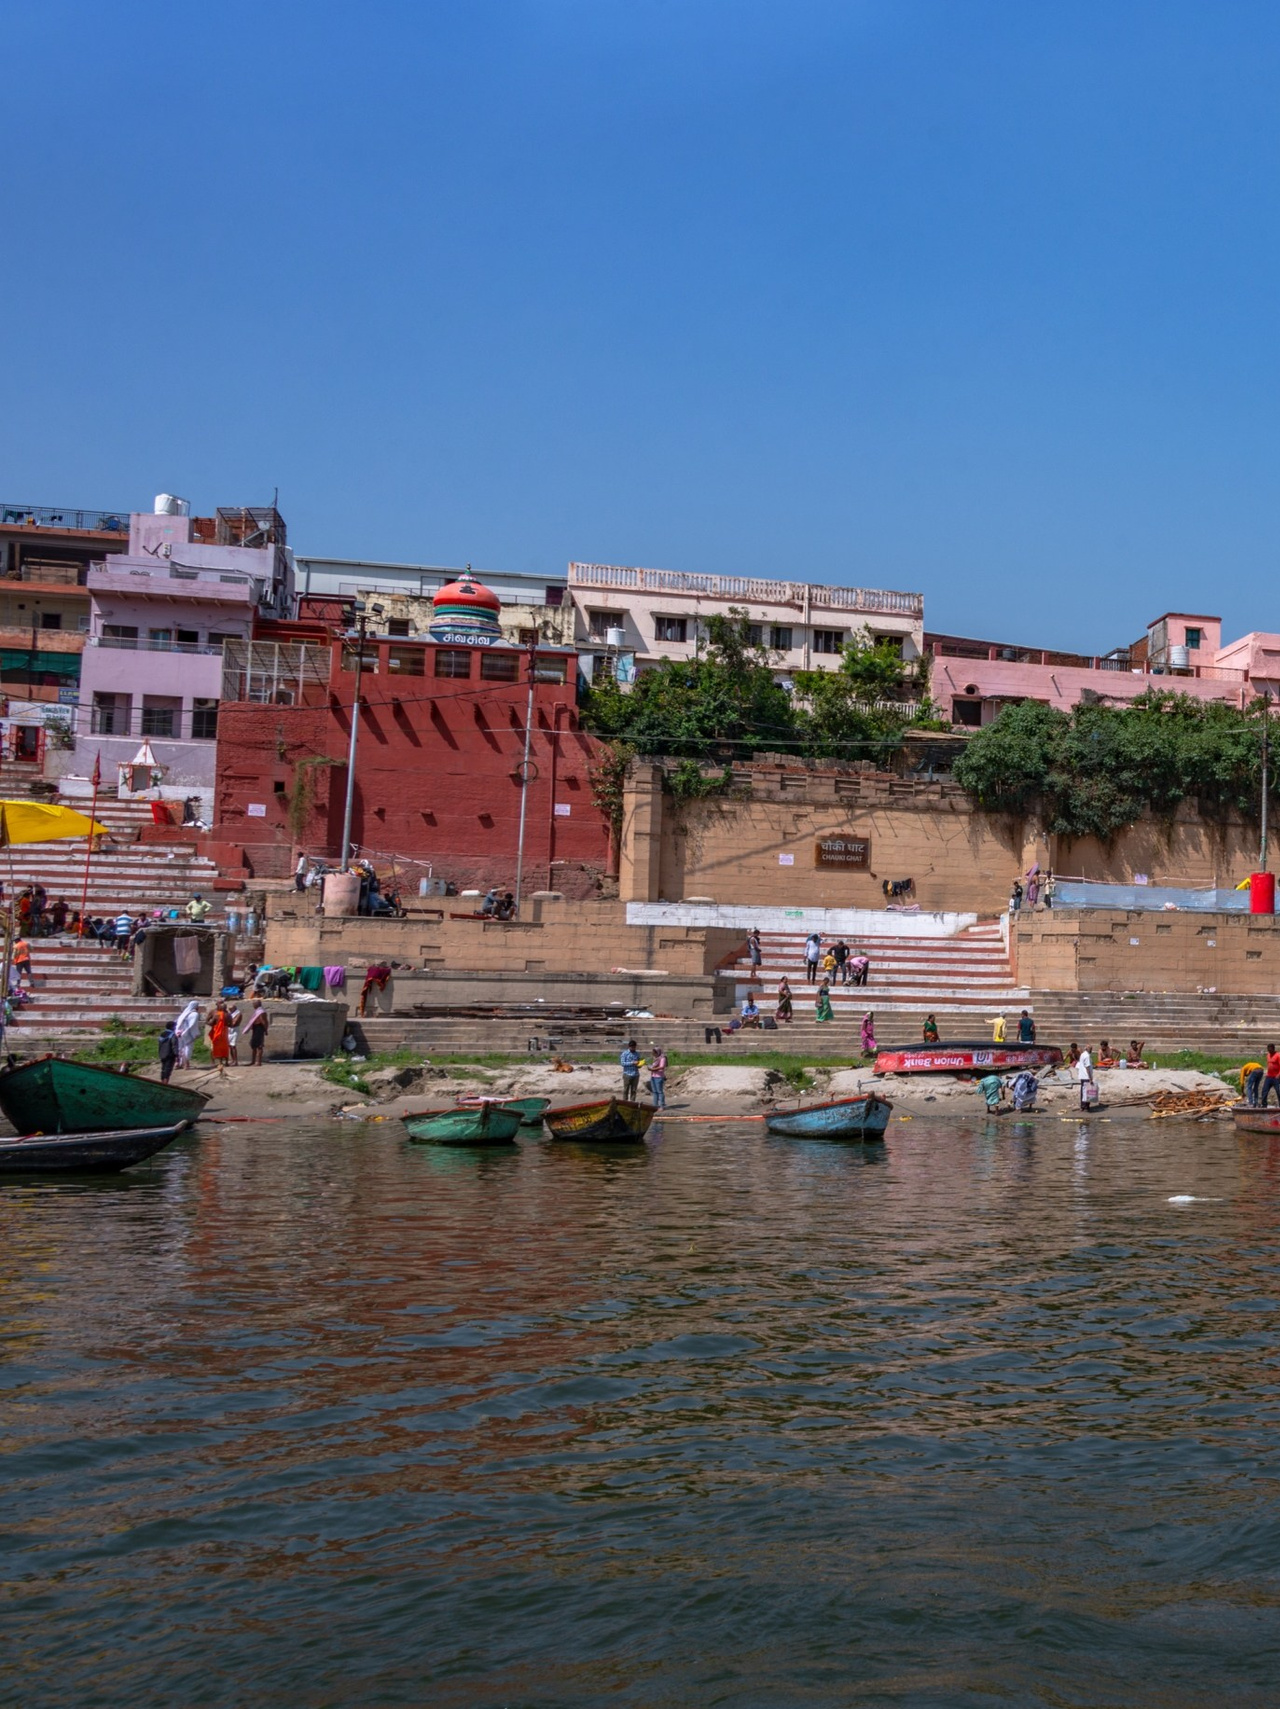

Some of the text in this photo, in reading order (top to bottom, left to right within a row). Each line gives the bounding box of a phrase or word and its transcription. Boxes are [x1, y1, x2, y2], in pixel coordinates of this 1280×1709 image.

[847, 843, 865, 853] घाट
[846, 854, 863, 862] GHAT
[904, 1057, 964, 1068] Union Bank
